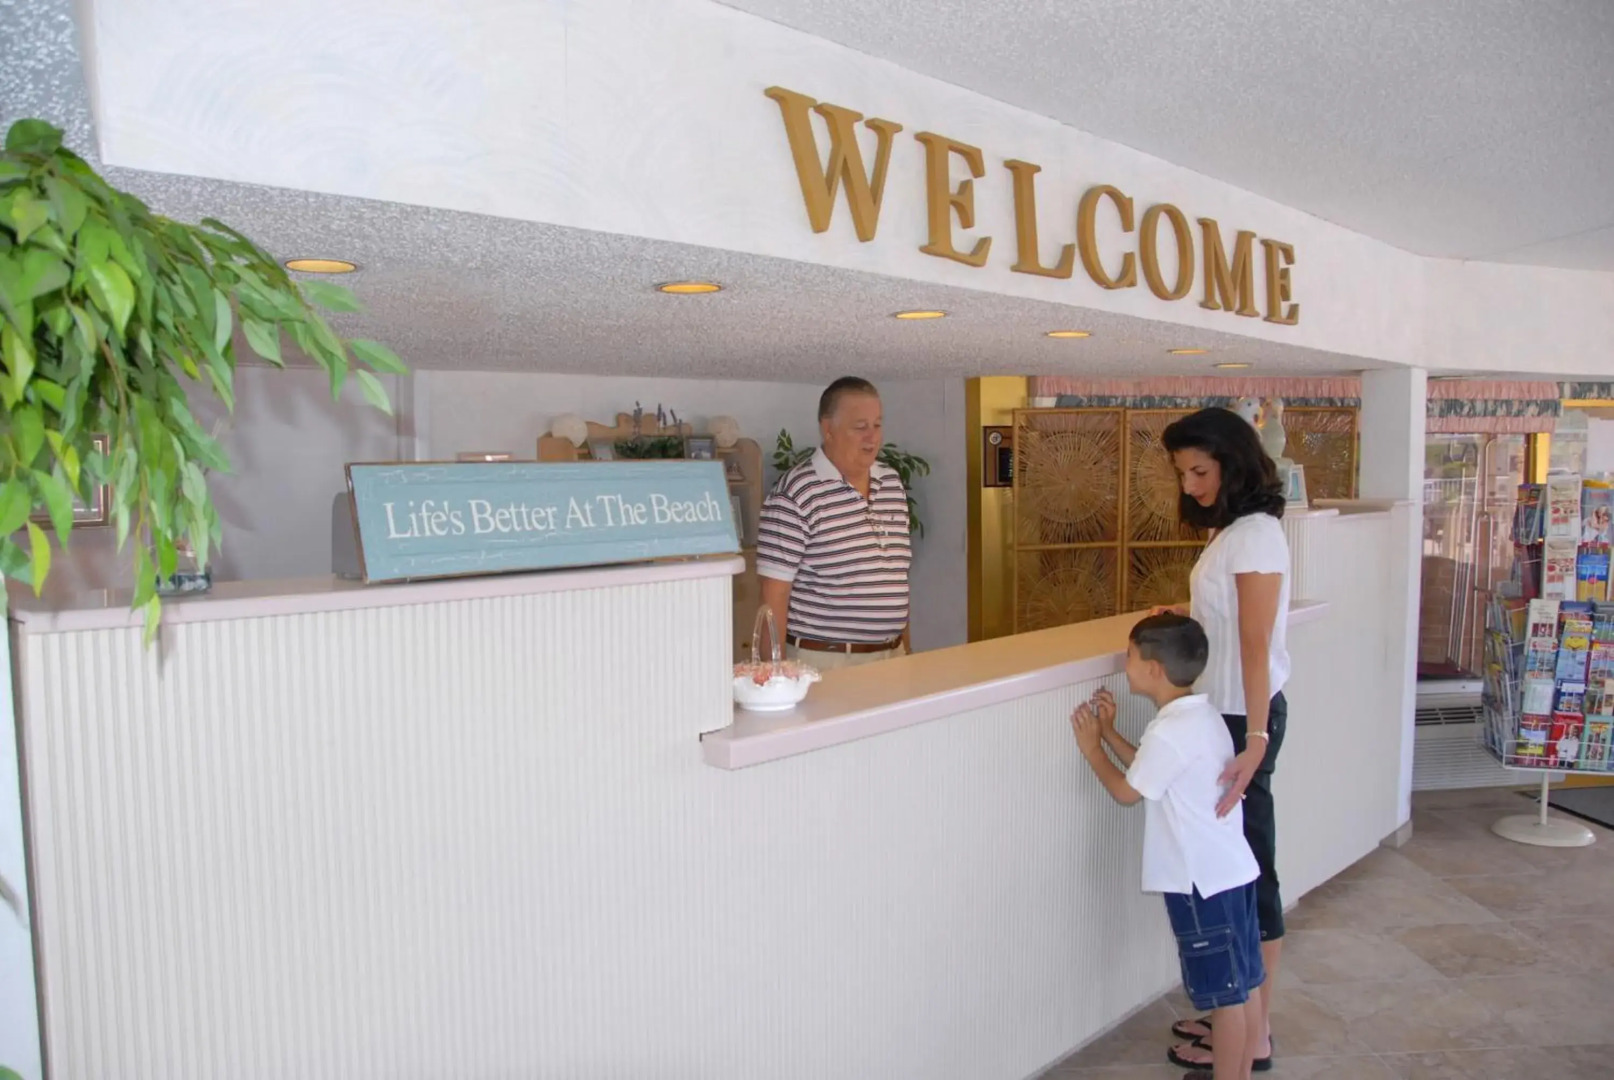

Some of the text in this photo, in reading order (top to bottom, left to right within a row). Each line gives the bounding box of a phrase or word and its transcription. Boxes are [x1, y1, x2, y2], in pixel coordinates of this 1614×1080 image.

[765, 86, 1299, 325] WELCOME
[384, 491, 721, 539] Life's Better At The Beach
